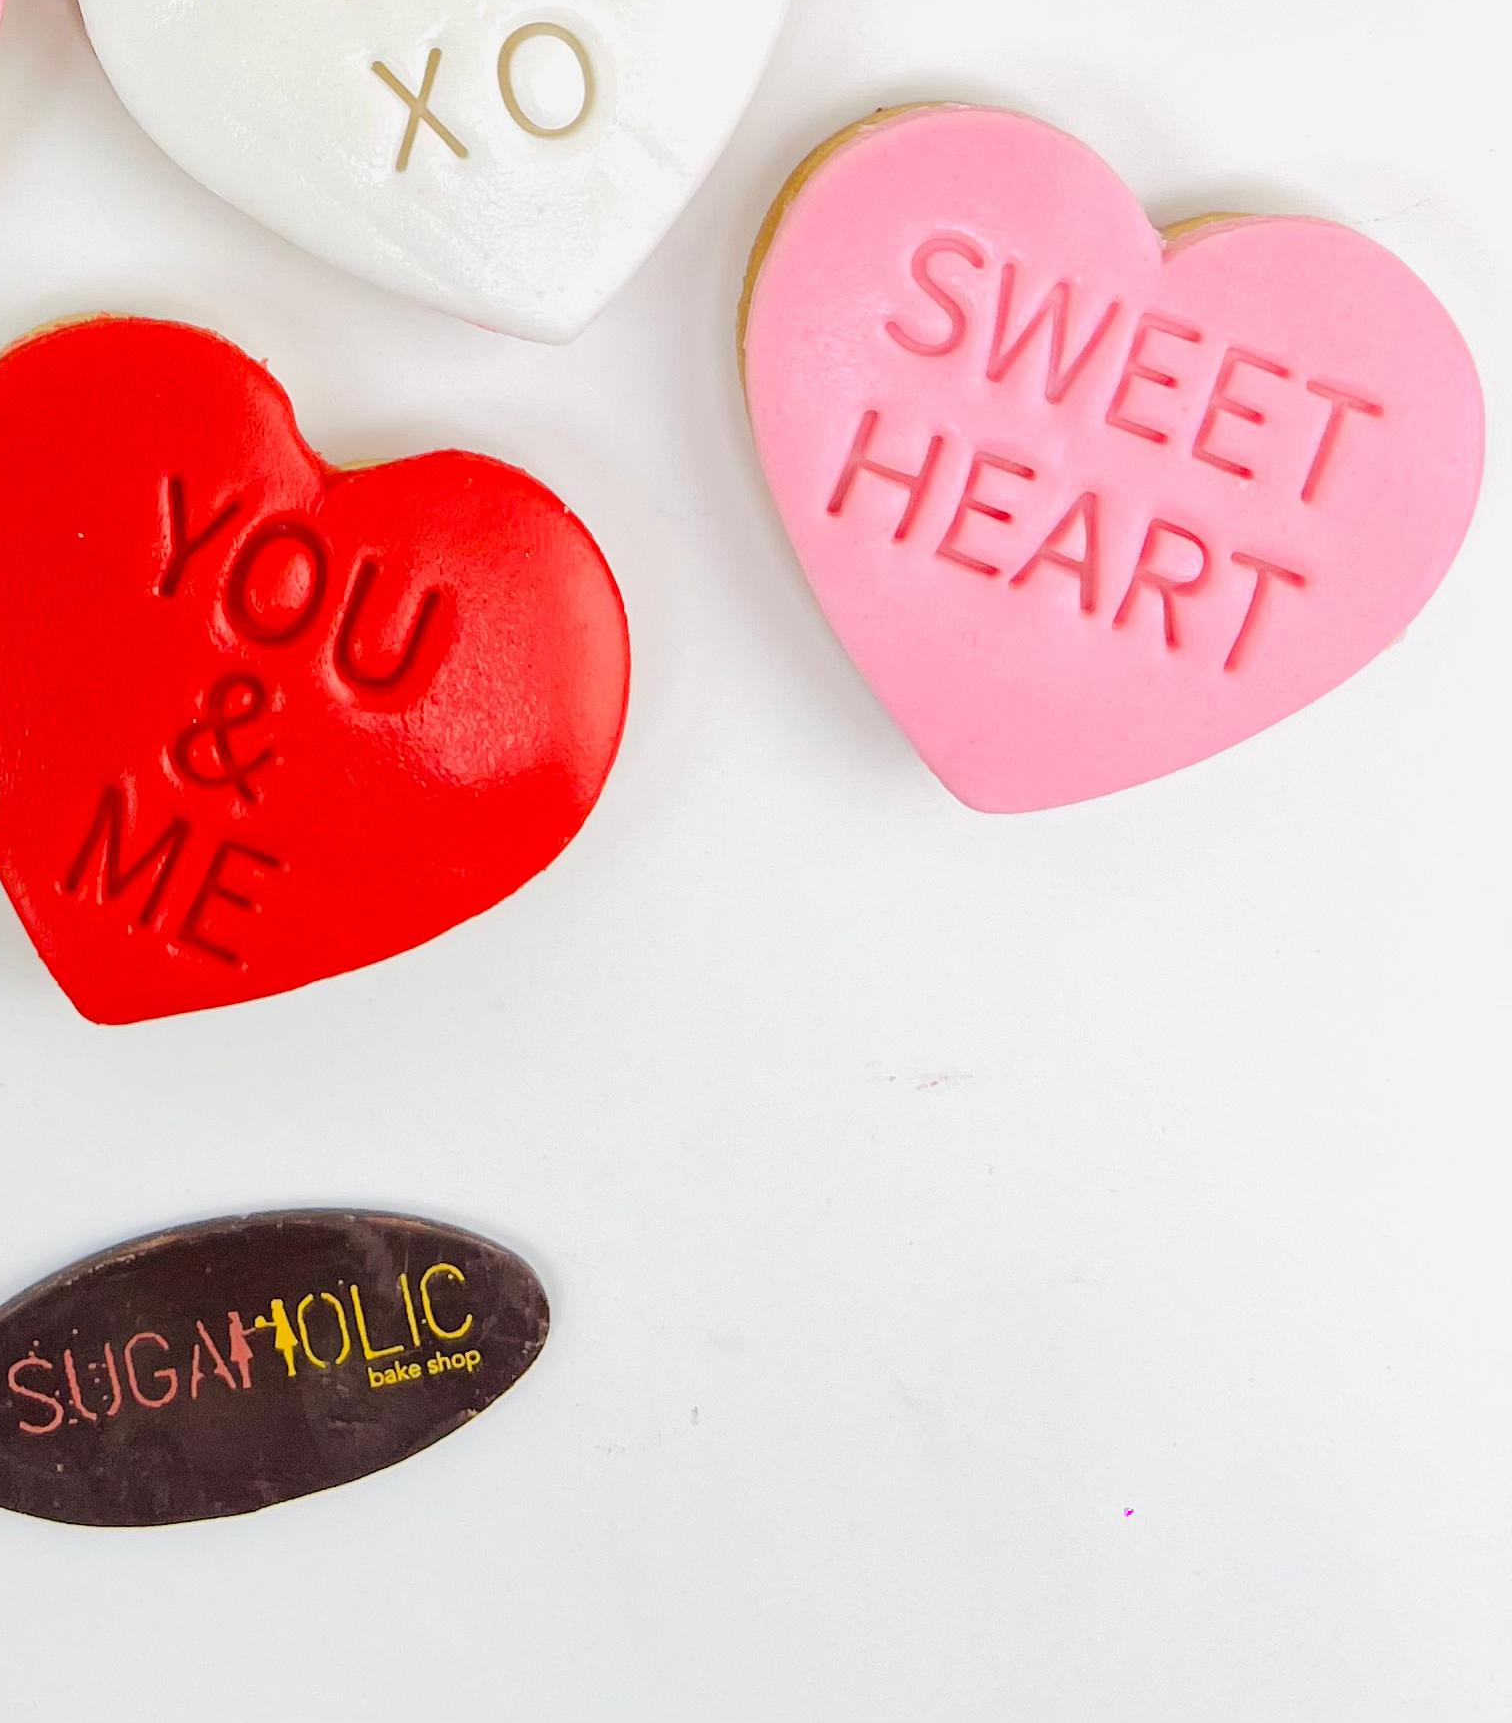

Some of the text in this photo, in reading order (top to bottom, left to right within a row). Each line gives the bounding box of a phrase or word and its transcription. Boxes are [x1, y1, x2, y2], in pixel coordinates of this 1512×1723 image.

[371, 22, 596, 172] XO
[884, 237, 1384, 503] SWEET
[160, 474, 442, 692] YOU
[826, 409, 1307, 672] HEART
[174, 672, 273, 805] &
[65, 784, 281, 966] ME
[367, 1345, 481, 1389] bake shop
